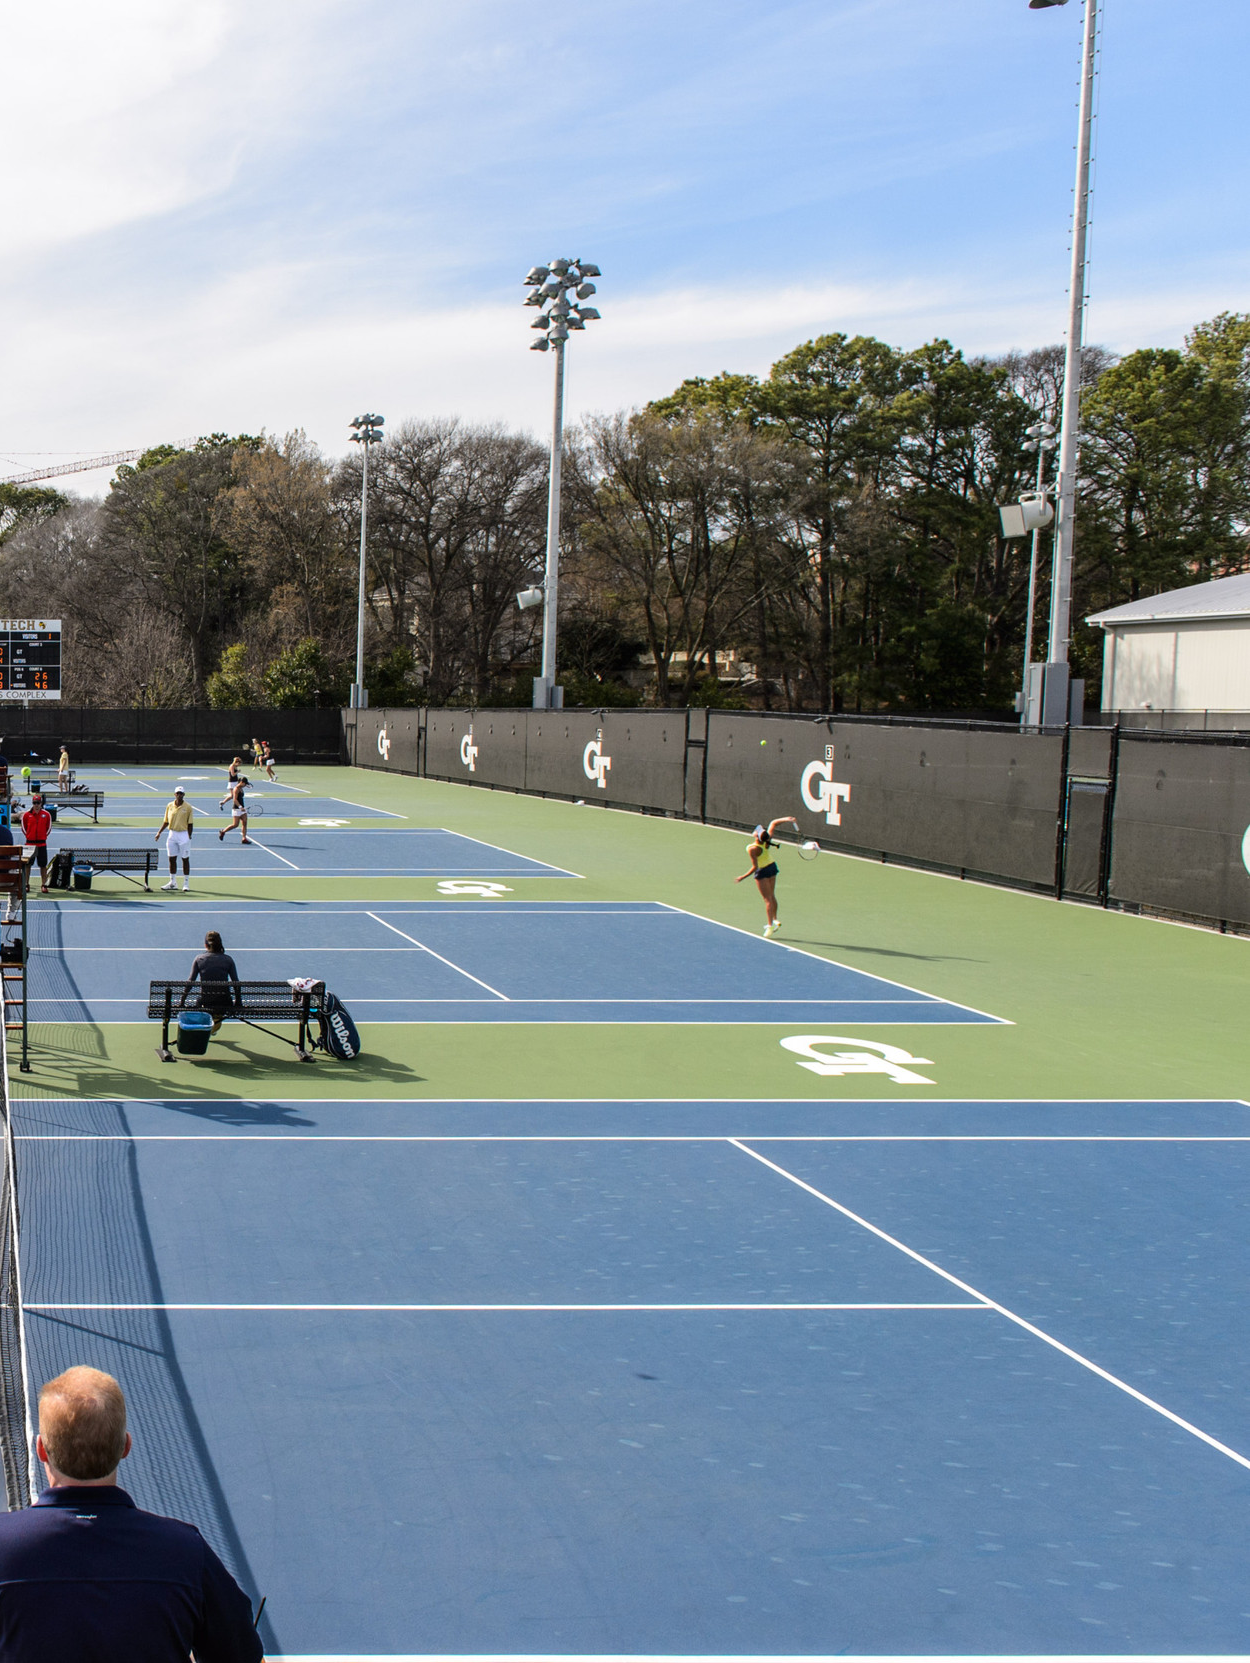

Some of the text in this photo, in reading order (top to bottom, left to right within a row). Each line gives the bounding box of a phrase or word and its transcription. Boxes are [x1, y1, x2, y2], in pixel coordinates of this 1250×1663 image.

[1, 620, 36, 630] TECH
[378, 729, 390, 760] GT
[460, 734, 478, 772] GT
[583, 741, 612, 788] GT
[800, 760, 851, 826] GT
[330, 1012, 355, 1059] Wilson
[780, 1035, 938, 1084] GT
